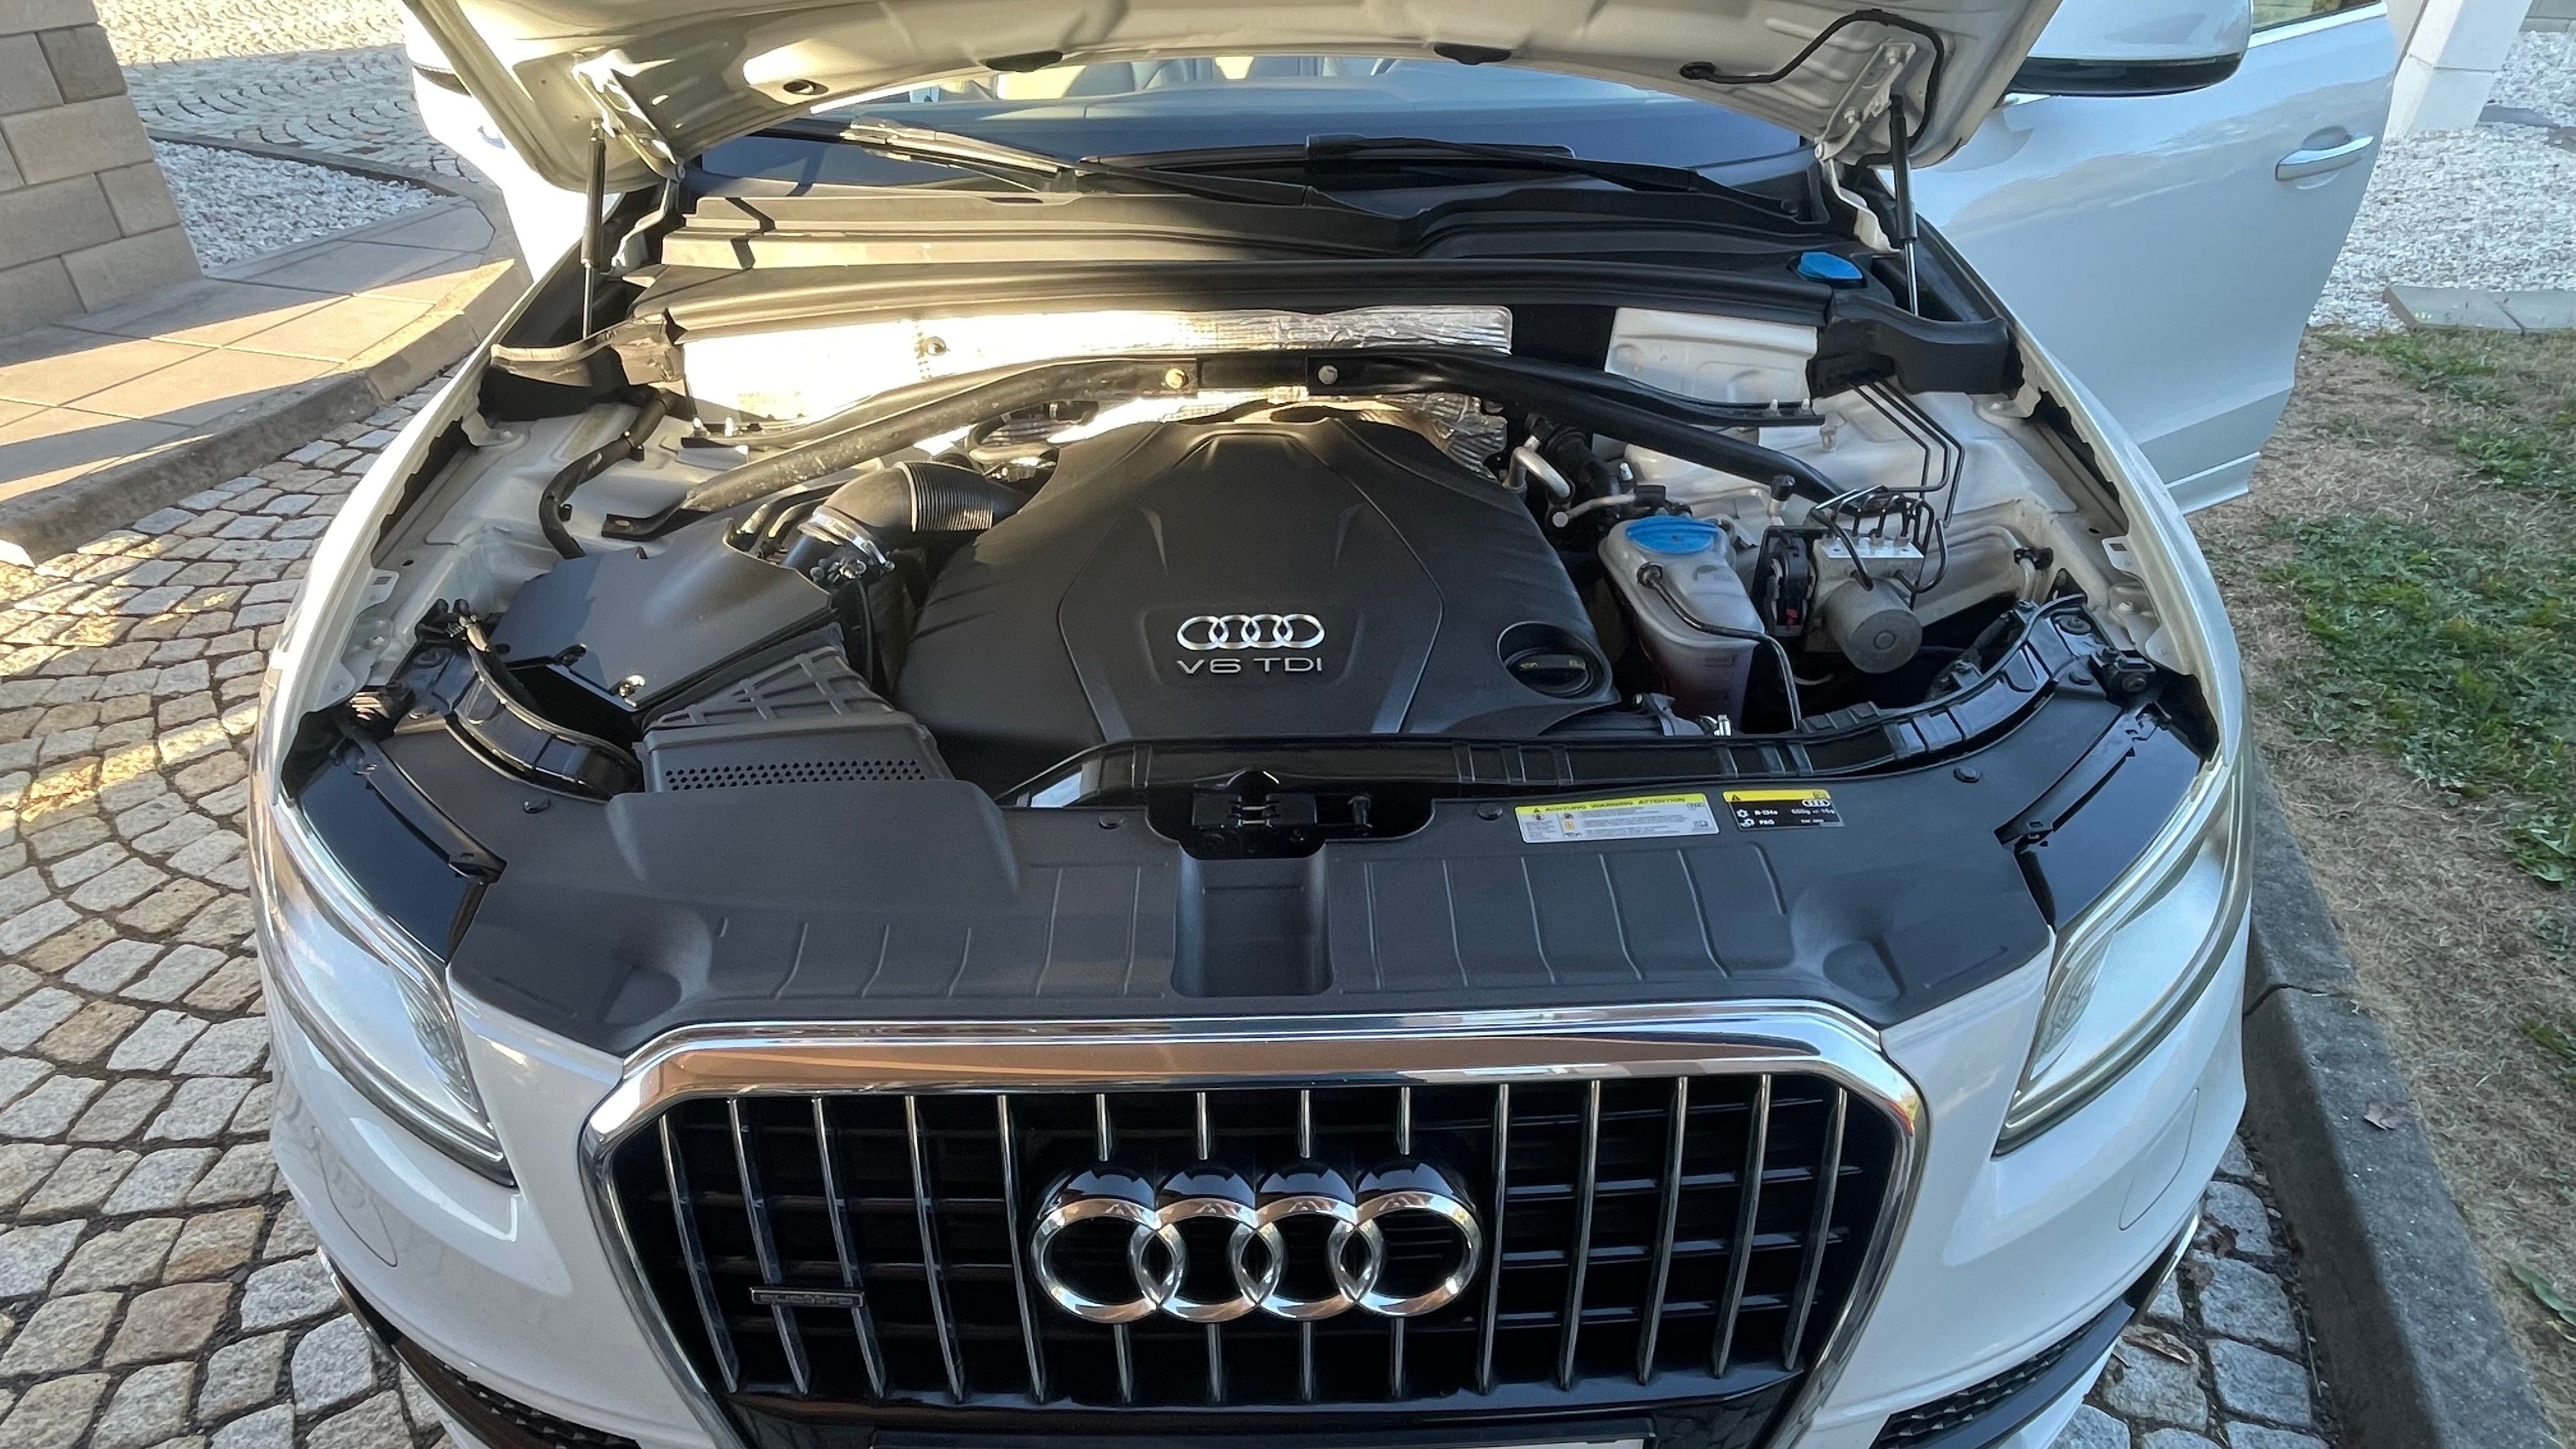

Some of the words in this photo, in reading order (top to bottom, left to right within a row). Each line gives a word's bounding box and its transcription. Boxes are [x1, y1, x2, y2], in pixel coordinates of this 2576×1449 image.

[1176, 657, 1242, 675] V6
[1253, 657, 1323, 673] TDI
[1591, 801, 1634, 809] WARNING
